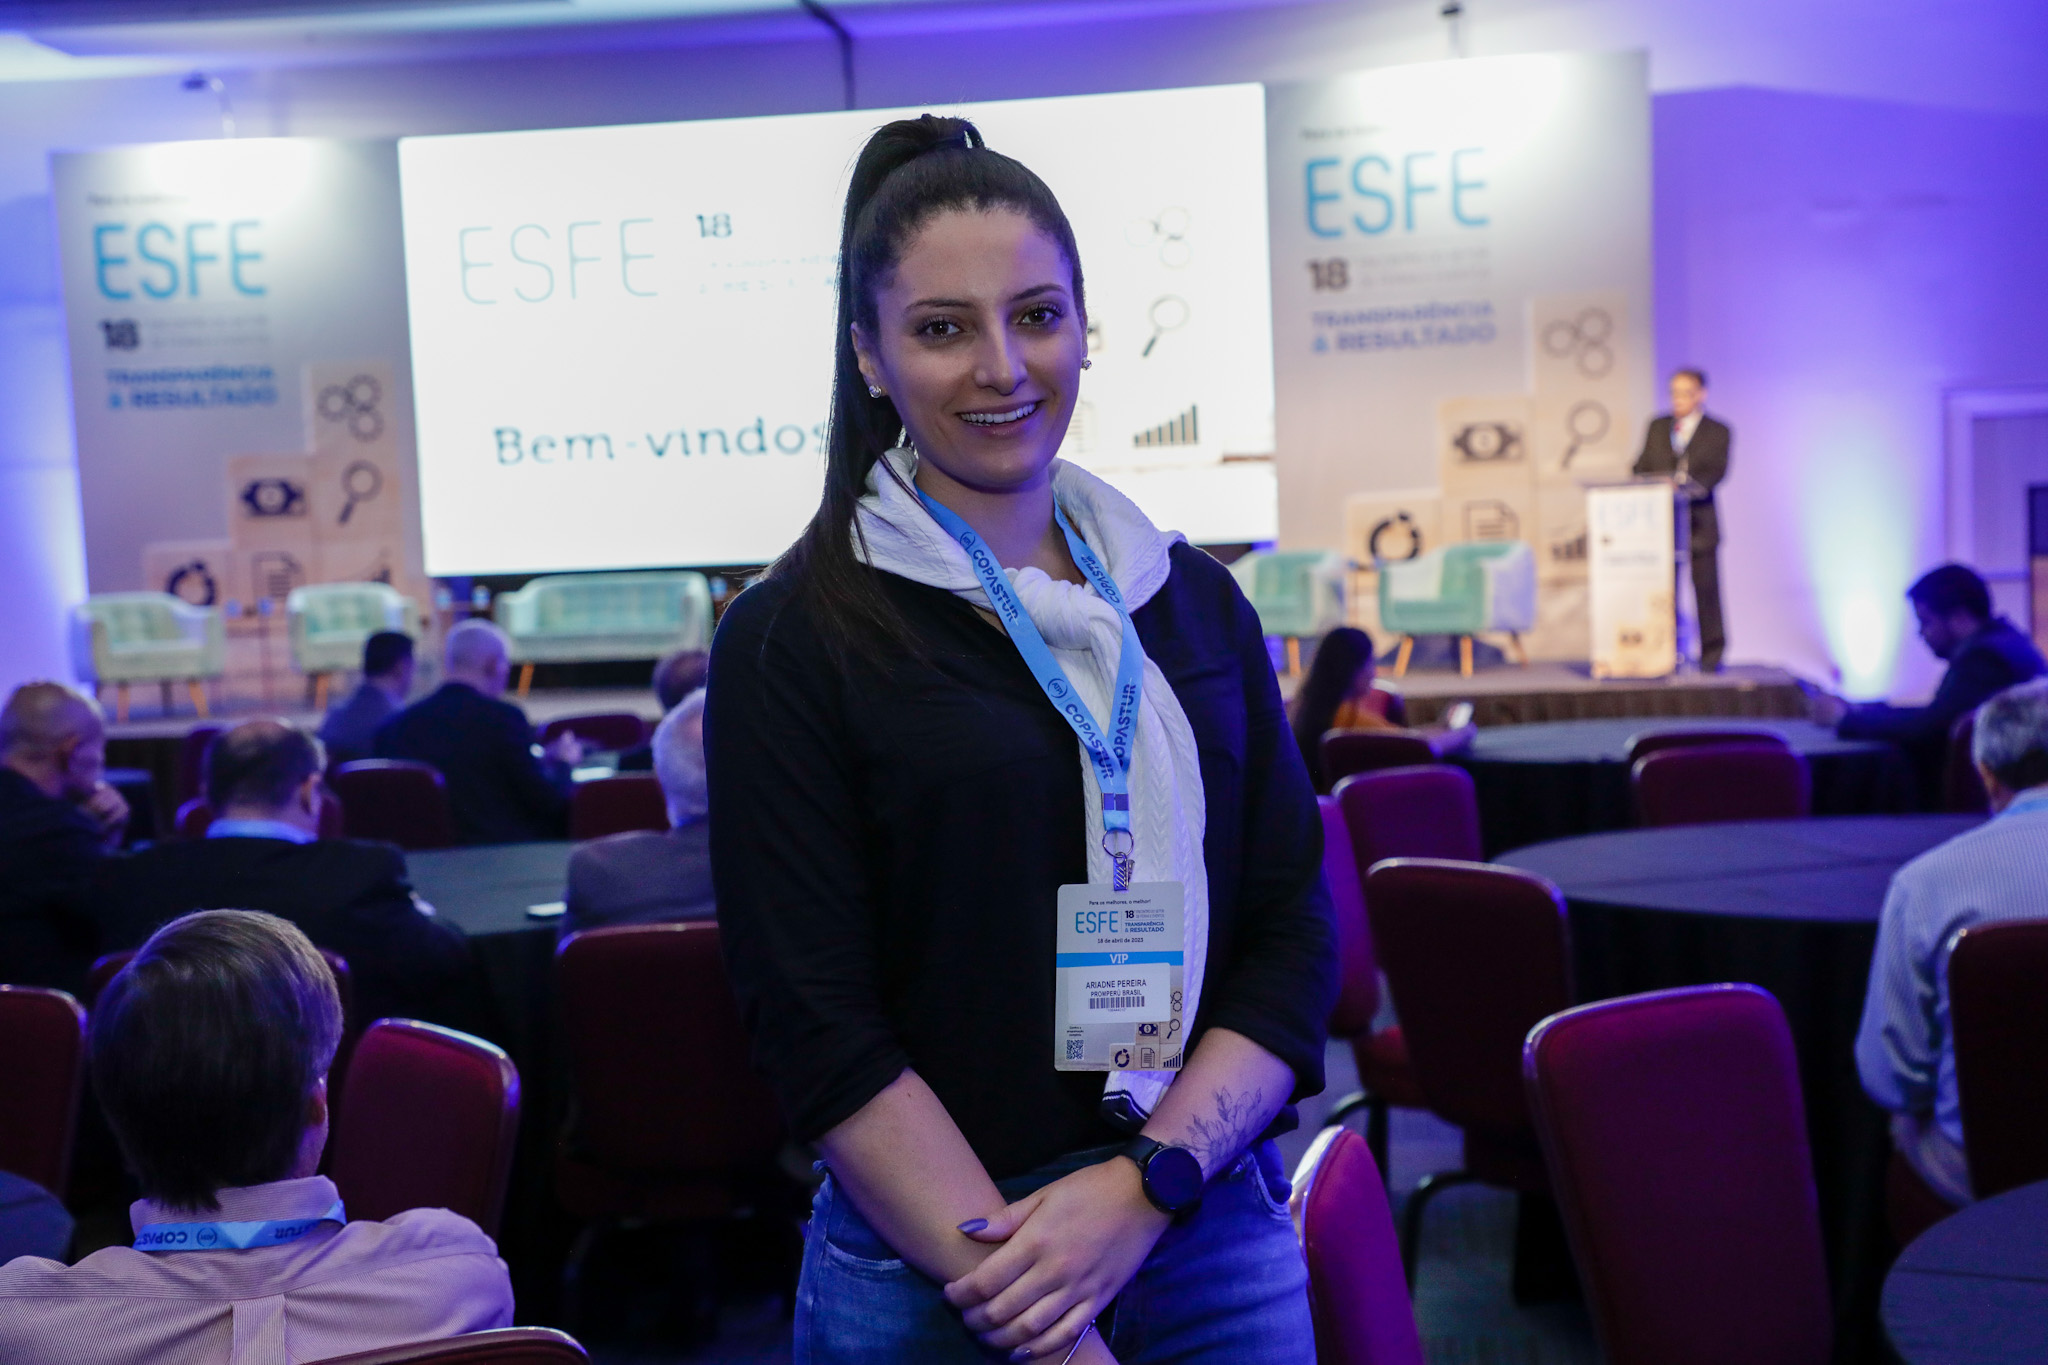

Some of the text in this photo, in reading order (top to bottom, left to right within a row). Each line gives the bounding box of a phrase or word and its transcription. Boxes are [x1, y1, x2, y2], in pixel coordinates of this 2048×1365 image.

[1305, 148, 1491, 239] ESFE
[696, 213, 733, 238] 18
[92, 220, 268, 301] ESFE
[459, 217, 659, 305] ESFE
[1306, 257, 1349, 292] 18
[100, 318, 141, 351] 18
[973, 549, 1019, 622] COPASTUR
[1081, 554, 1121, 604] COPASTUR
[1065, 703, 1115, 780] COPASTUR
[1075, 910, 1135, 934] ESFE 18
[1109, 953, 1129, 964] VIP
[1085, 979, 1147, 989] ARIADNE PEREIRA
